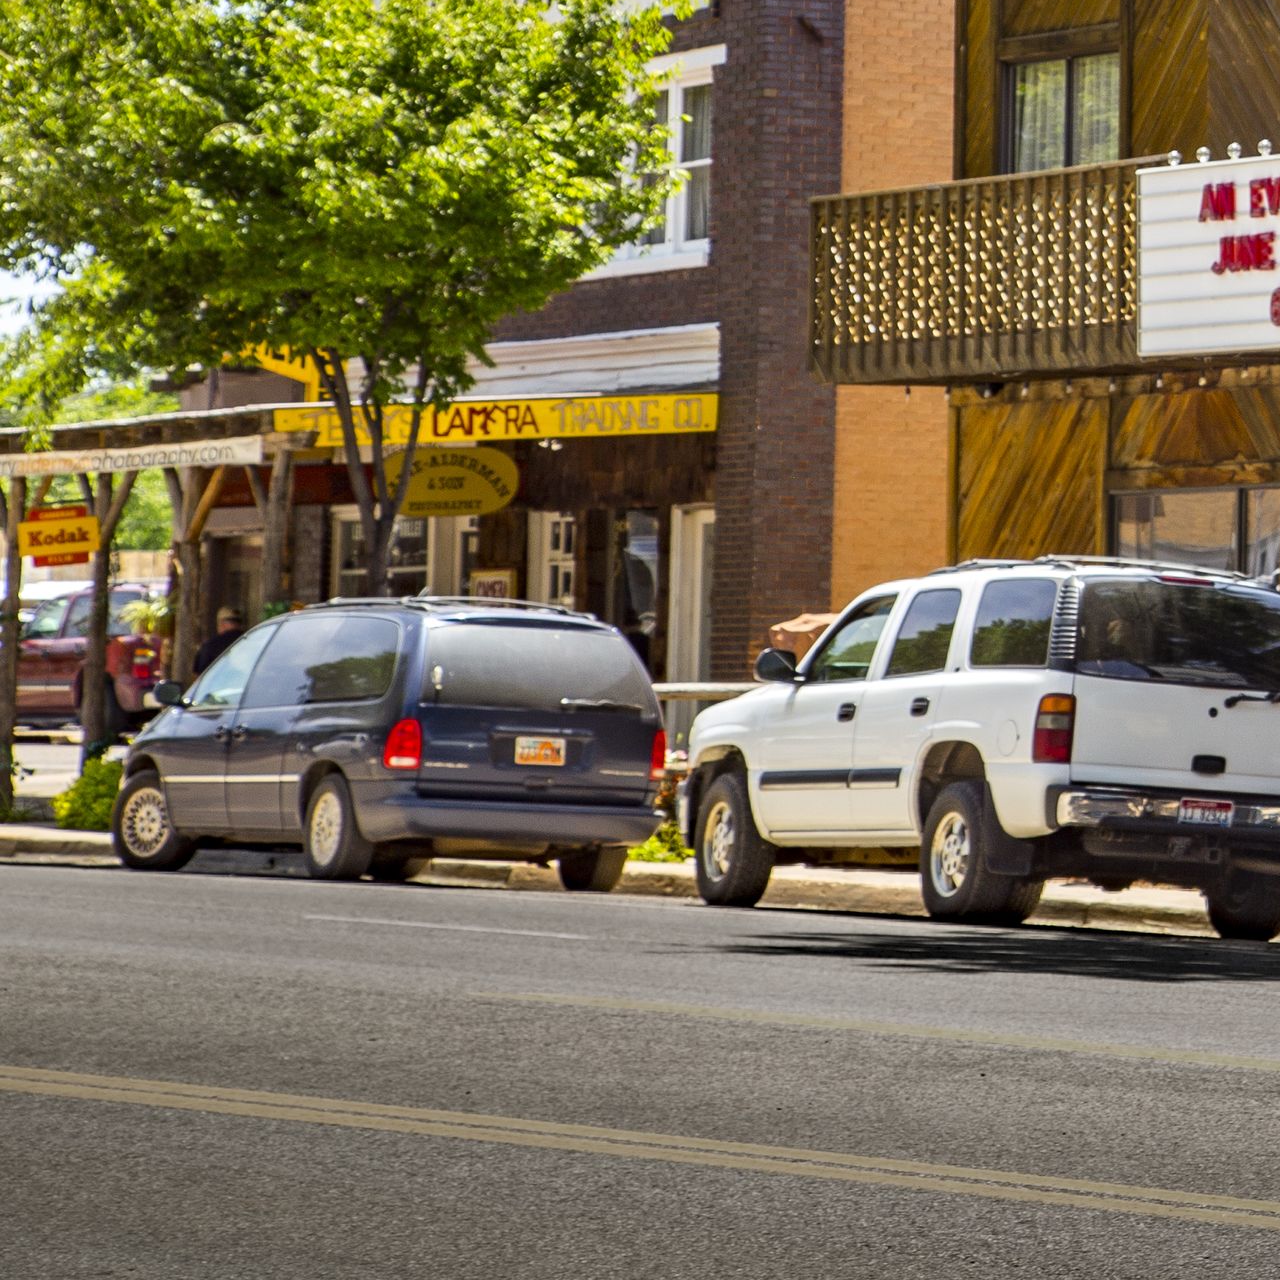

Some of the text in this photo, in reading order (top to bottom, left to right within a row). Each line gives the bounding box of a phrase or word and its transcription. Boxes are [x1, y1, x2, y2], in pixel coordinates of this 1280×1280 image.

[1198, 181, 1237, 222] AN
[1211, 231, 1277, 275] JUNE
[27, 527, 89, 548] Kodak
